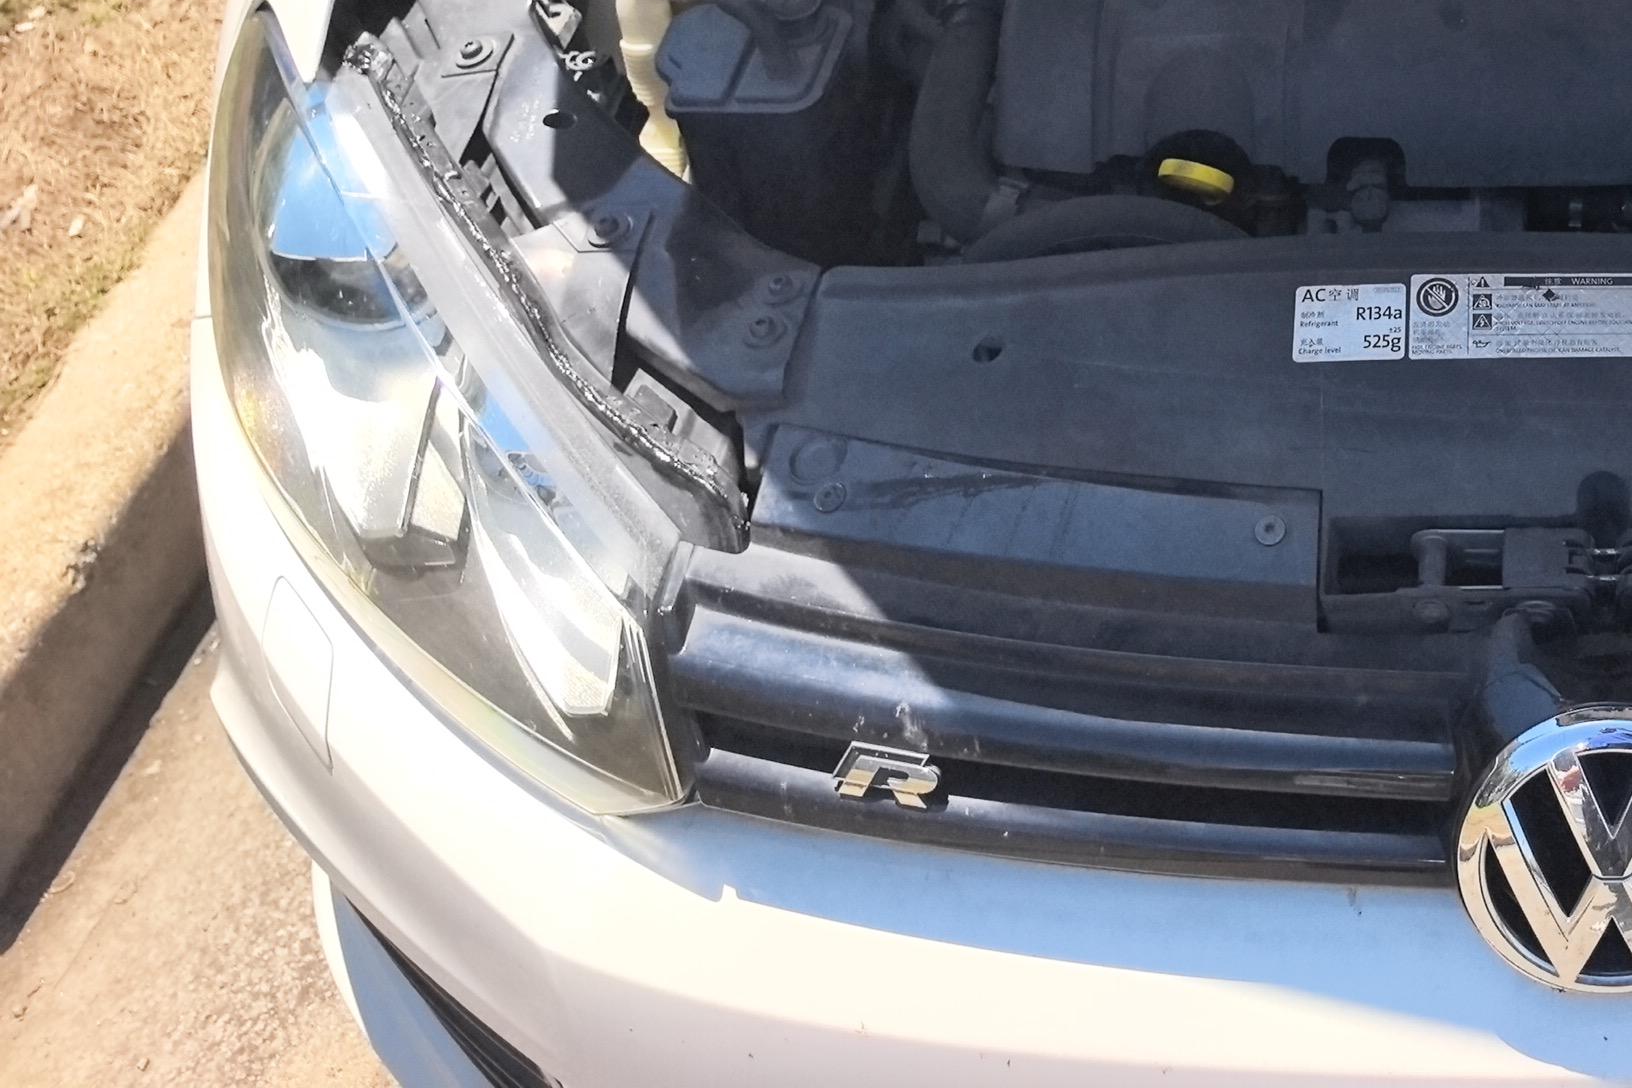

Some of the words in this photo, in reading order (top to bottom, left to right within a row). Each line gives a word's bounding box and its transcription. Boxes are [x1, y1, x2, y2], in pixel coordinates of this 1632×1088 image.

[1571, 277, 1614, 285] WARNING
[1301, 288, 1326, 303] AC
[1356, 305, 1403, 320] R134a
[1300, 320, 1339, 328] Refrigerant
[1298, 347, 1323, 356] Charge
[1324, 346, 1342, 354] level
[1363, 334, 1402, 353] 525g
[833, 740, 942, 810] R
